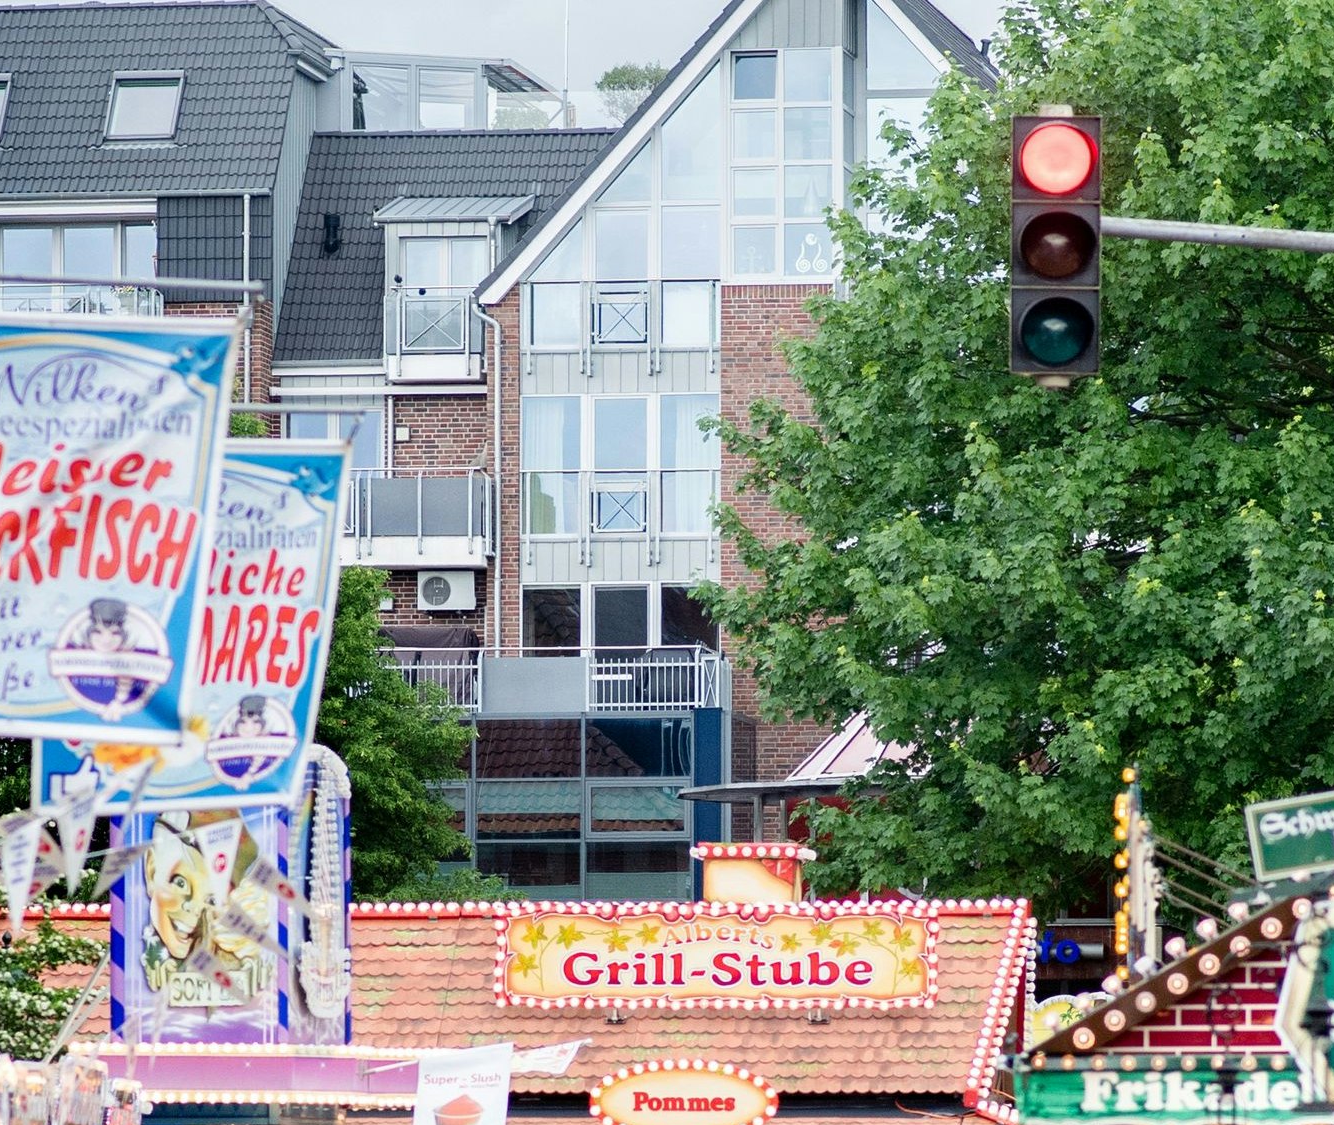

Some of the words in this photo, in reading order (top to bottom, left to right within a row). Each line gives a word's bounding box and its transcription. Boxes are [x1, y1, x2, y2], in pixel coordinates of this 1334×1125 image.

[662, 920, 776, 951] Alberts
[561, 950, 874, 987] Grill-Stube
[632, 1092, 736, 1113] Pommes
